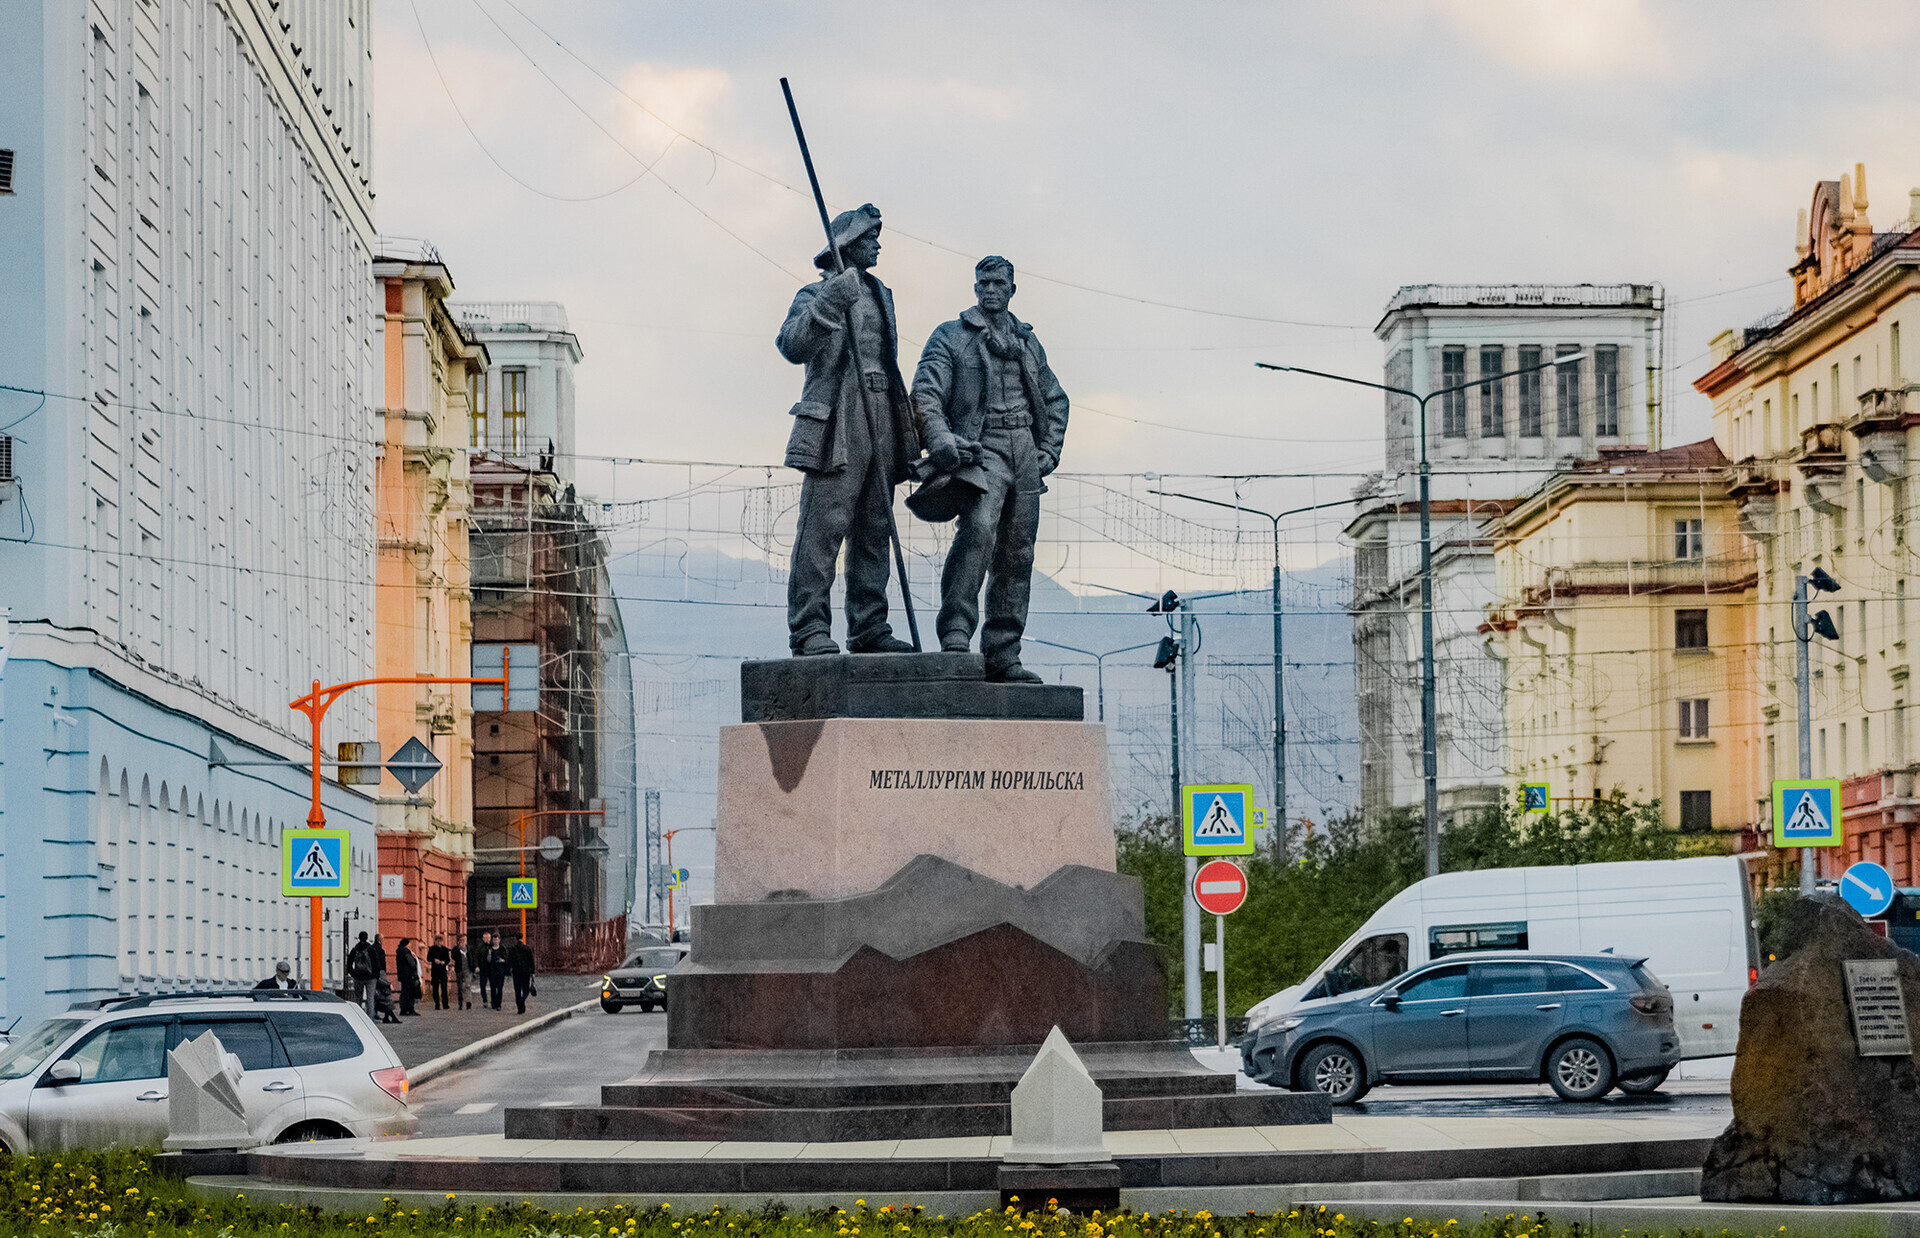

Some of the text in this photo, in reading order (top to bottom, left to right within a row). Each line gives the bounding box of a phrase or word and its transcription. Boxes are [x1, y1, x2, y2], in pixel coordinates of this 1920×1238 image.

[869, 770, 1084, 790] МЕТАЛЛУРГАМ НОРИЛЬСКА
[388, 878, 396, 888] 6
